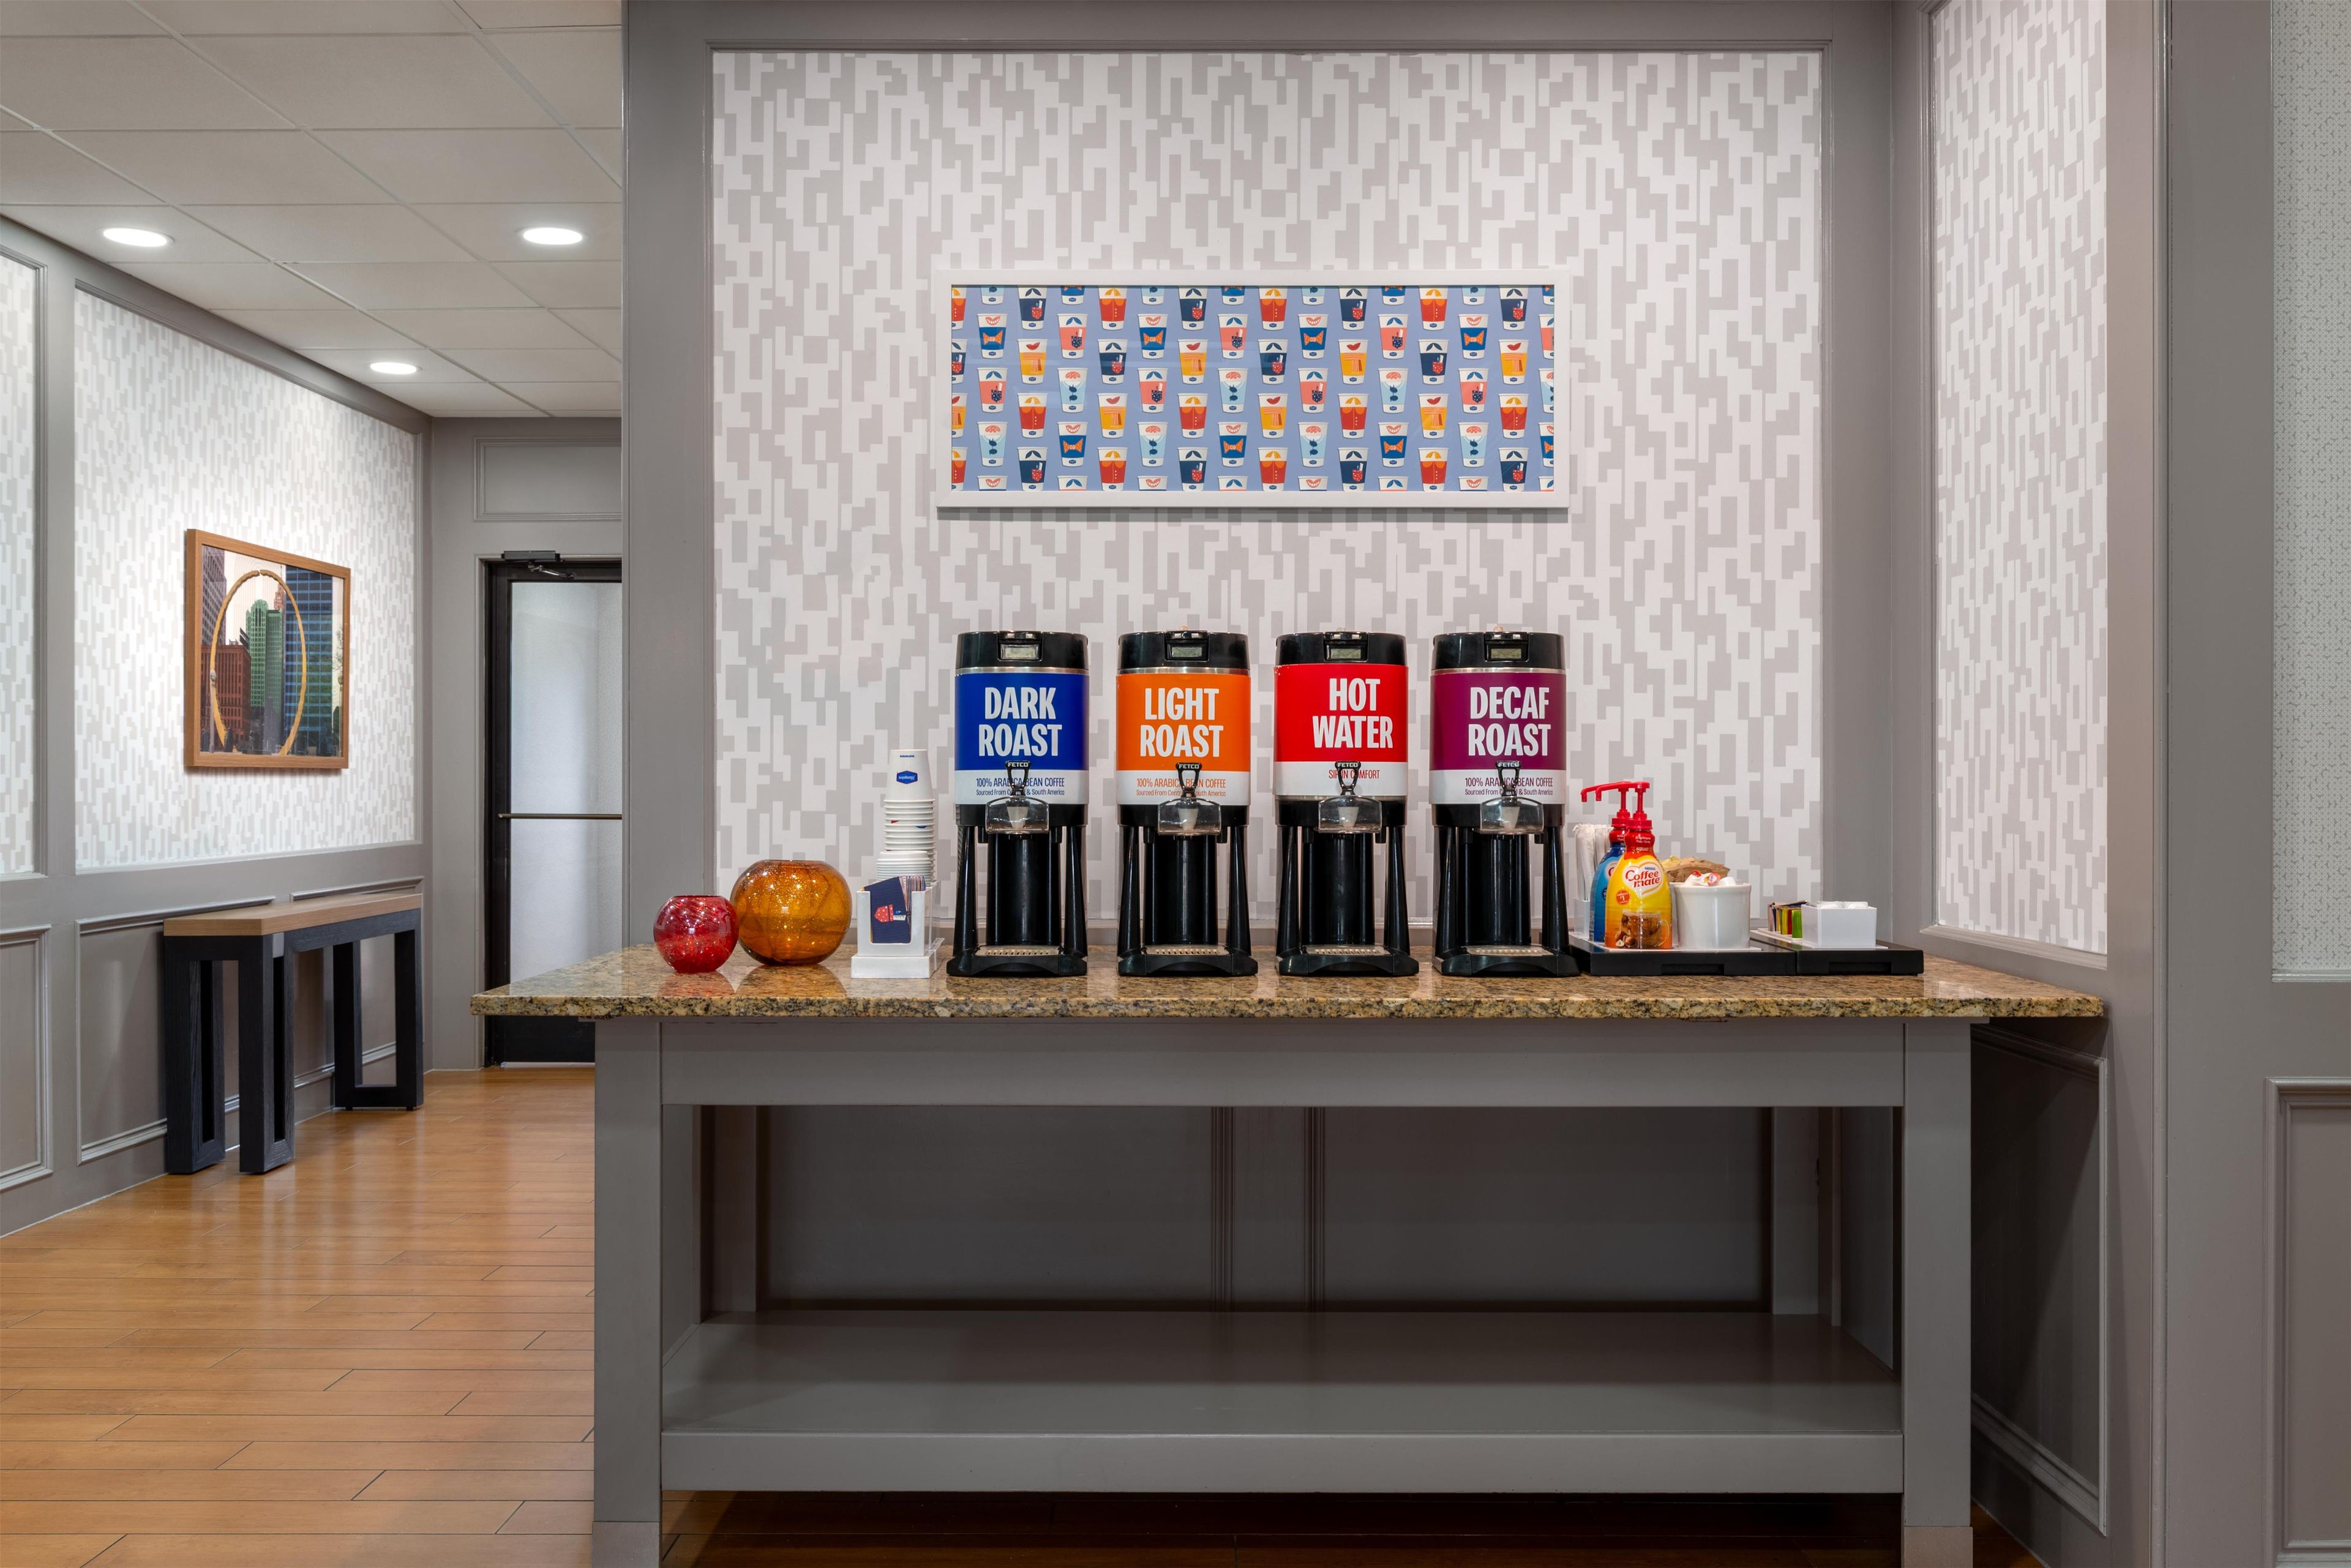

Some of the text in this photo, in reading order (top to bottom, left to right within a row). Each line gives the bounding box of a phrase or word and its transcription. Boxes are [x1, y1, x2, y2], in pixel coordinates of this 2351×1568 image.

[985, 687, 1056, 719] DARK
[1145, 687, 1220, 720] LIGHT
[1329, 678, 1381, 711] HOT
[1470, 686, 1550, 719] DECAF
[979, 724, 1062, 756] ROAST
[1140, 724, 1224, 757] ROAST
[1312, 716, 1393, 748] WATER
[1468, 723, 1551, 756] ROAST
[976, 778, 1065, 787] 100% ARACA BEAN COFFEE
[1136, 778, 1226, 788] 100% ARABIC BEN COFFEE
[1351, 770, 1380, 779] CMFORT
[1465, 778, 1553, 787] 100% ARAICA BEAN COFFEE
[1625, 870, 1659, 881] Coffee
[1633, 877, 1660, 888] mate
